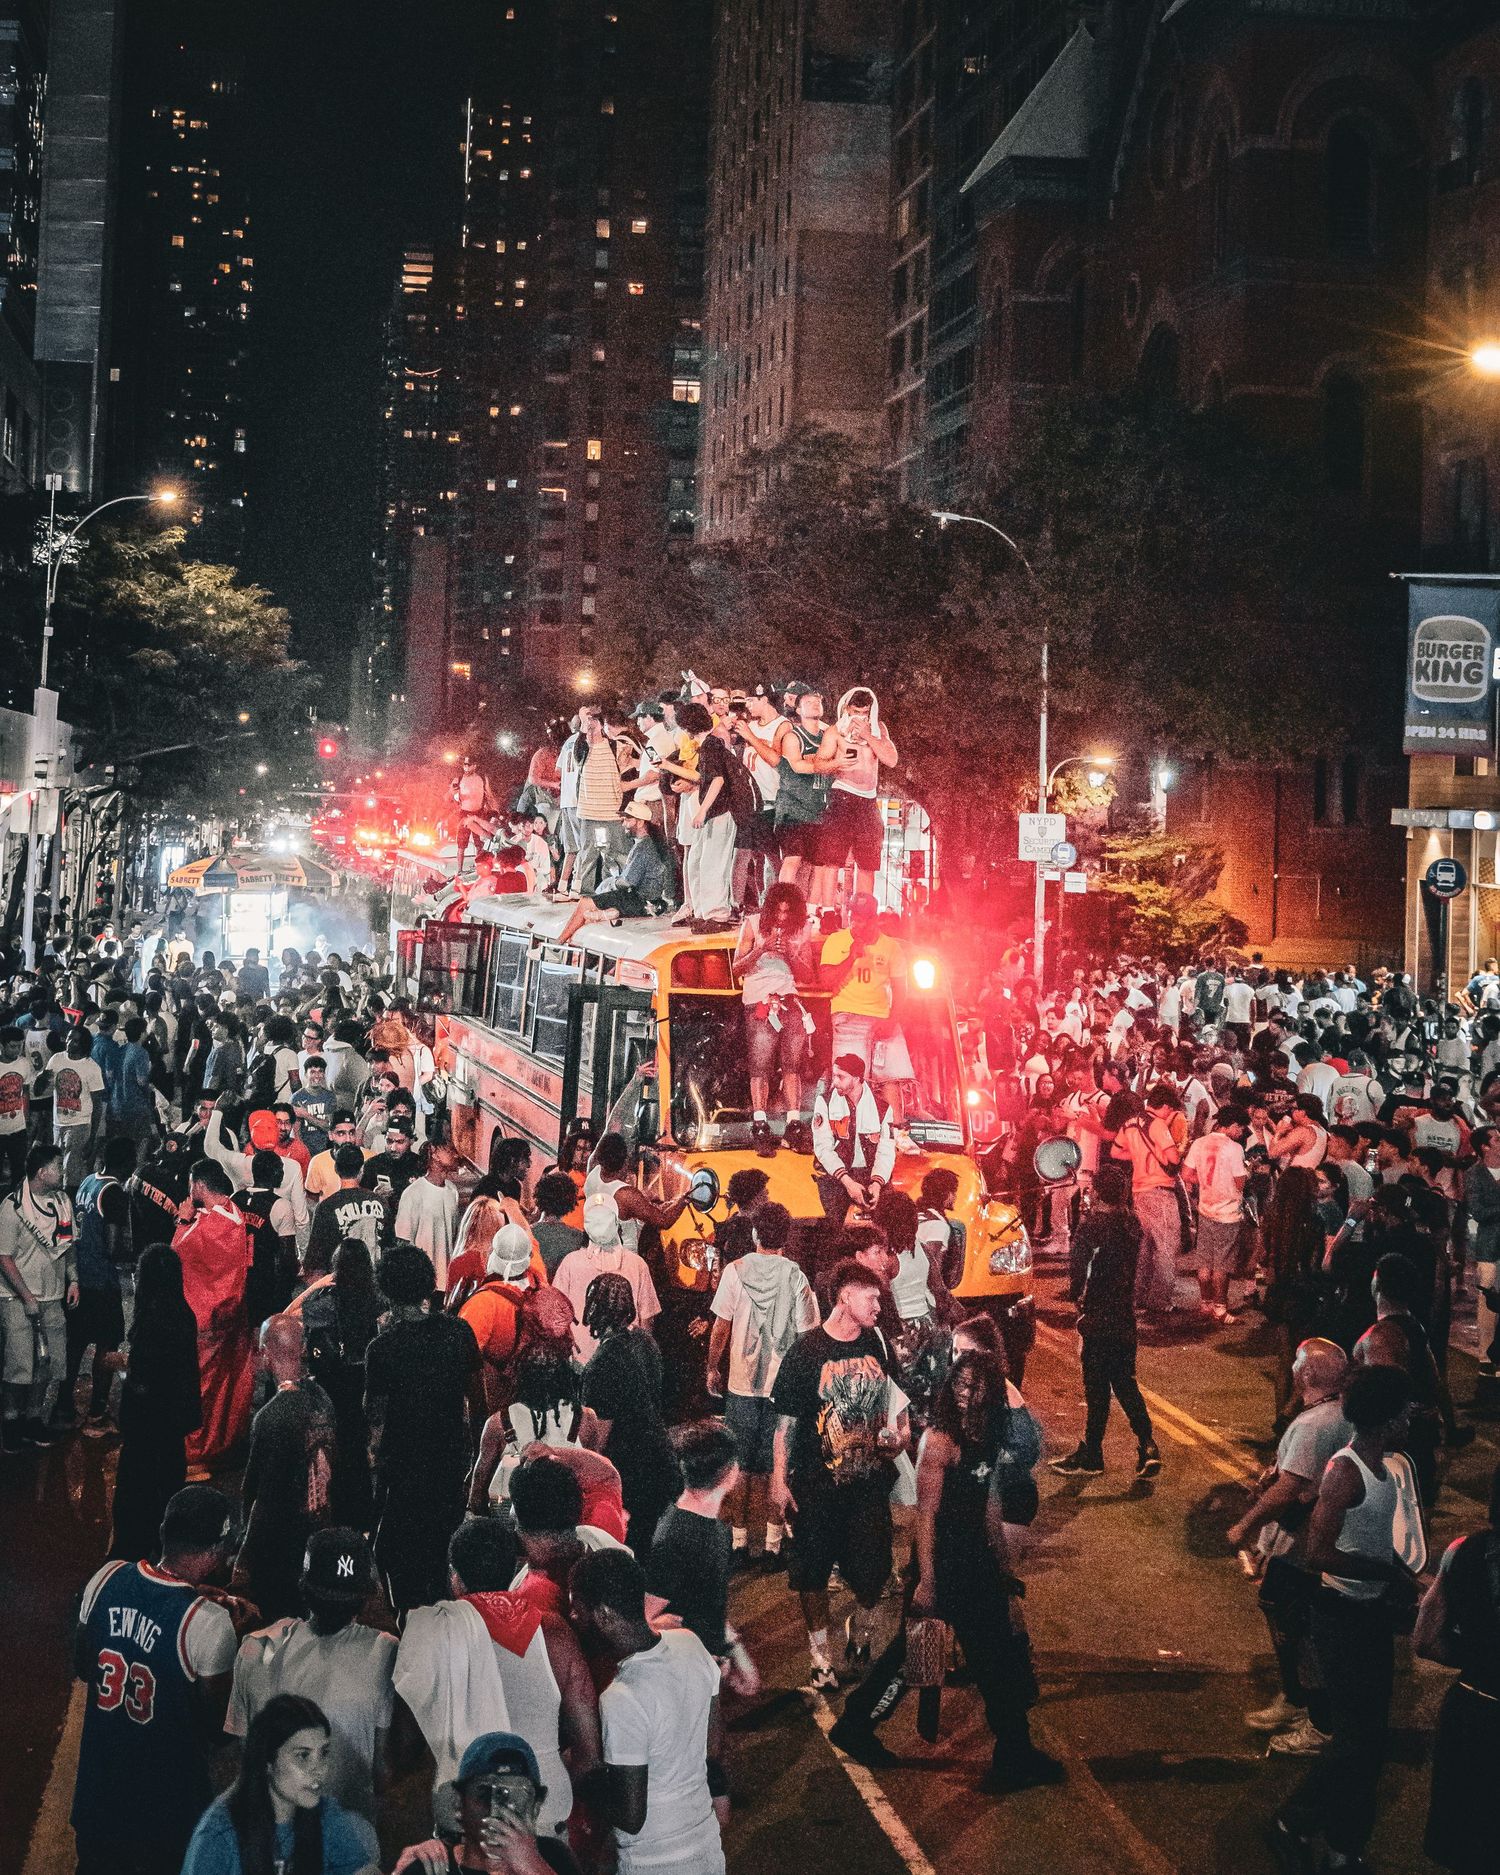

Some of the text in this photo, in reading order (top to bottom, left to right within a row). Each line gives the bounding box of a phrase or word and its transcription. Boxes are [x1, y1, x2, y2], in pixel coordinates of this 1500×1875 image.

[1417, 642, 1484, 661] BURGER
[1415, 660, 1484, 684] KING
[1029, 817, 1056, 826] NYPD
[170, 876, 201, 885] SABRETT
[239, 874, 273, 884] SABRETT
[857, 967, 871, 984] 10
[307, 1103, 325, 1115] NEW
[971, 1109, 996, 1133] OP
[336, 1555, 354, 1577] NY
[108, 1606, 162, 1654] EWING
[96, 1647, 157, 1726] 33
